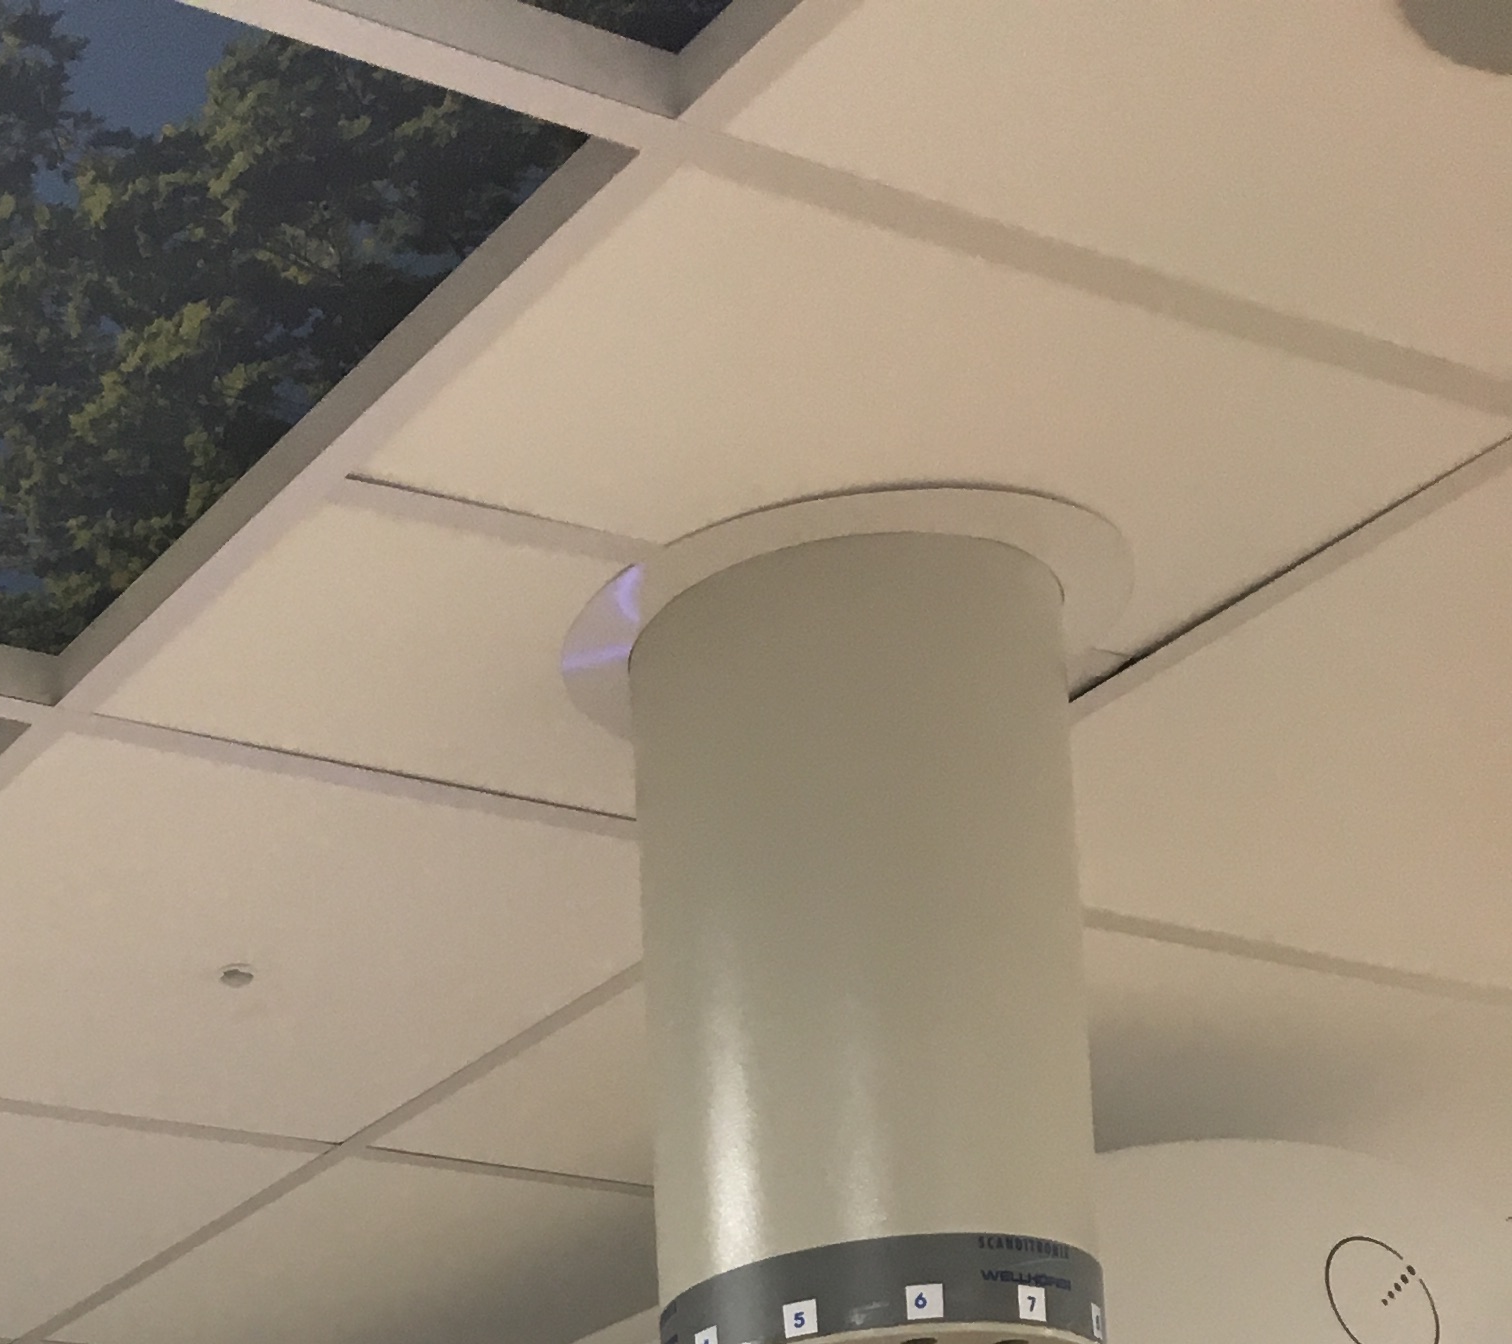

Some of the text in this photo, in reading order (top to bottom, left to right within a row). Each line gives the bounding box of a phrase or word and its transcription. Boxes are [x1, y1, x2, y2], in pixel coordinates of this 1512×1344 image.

[914, 1291, 927, 1309] 6
[1026, 1295, 1036, 1312] 7
[793, 1311, 805, 1328] 5
